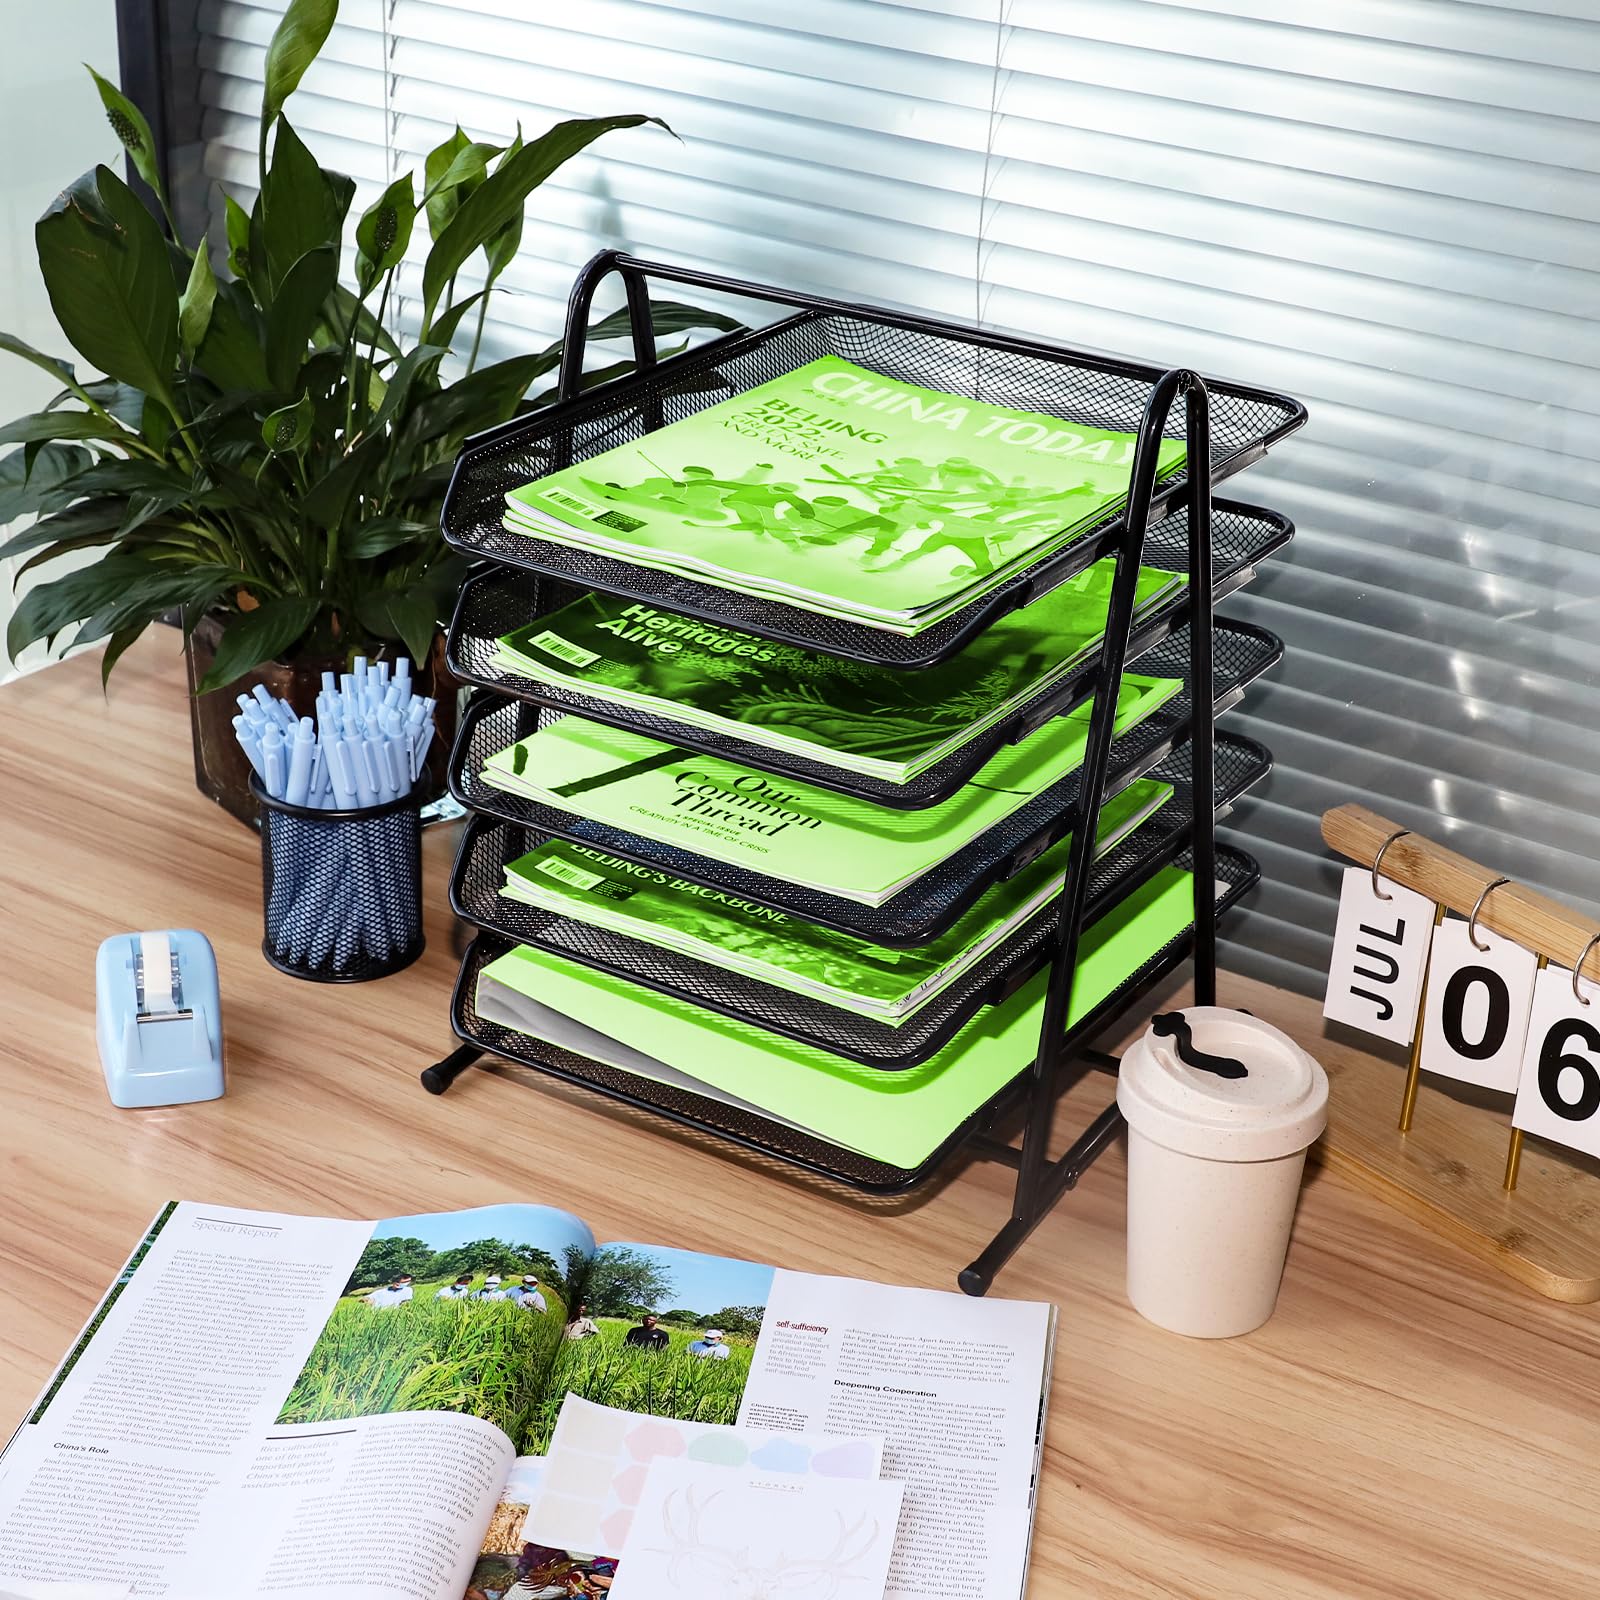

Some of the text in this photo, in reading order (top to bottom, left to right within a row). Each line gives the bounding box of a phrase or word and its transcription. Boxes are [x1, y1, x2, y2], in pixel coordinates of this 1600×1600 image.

[744, 407, 825, 442] 2022:
[763, 398, 888, 444] BEIJING
[811, 371, 969, 432] CHINA
[716, 420, 818, 460] AND MORE
[595, 618, 683, 653] Alive
[619, 603, 777, 662] Heritages
[671, 788, 790, 837] Thread
[675, 771, 822, 829] Common
[733, 775, 801, 805] Our
[629, 805, 681, 826] CREATIVITY
[701, 827, 724, 838] TIME
[723, 835, 739, 844] OF
[739, 840, 771, 854] CRISIS
[682, 814, 715, 829] SPECIAL
[717, 825, 742, 836] ISSUE
[570, 844, 672, 884] BEIJING'S
[668, 878, 789, 924] BACKBONE
[1350, 918, 1406, 1021] JUL
[1441, 965, 1510, 1060] 0
[1537, 1017, 1600, 1122] 6
[192, 1220, 279, 1239] Special Report
[775, 1320, 829, 1335] self-sufficiency
[833, 1379, 938, 1399] Deepening Cooperation
[53, 1442, 110, 1455] China's Role
